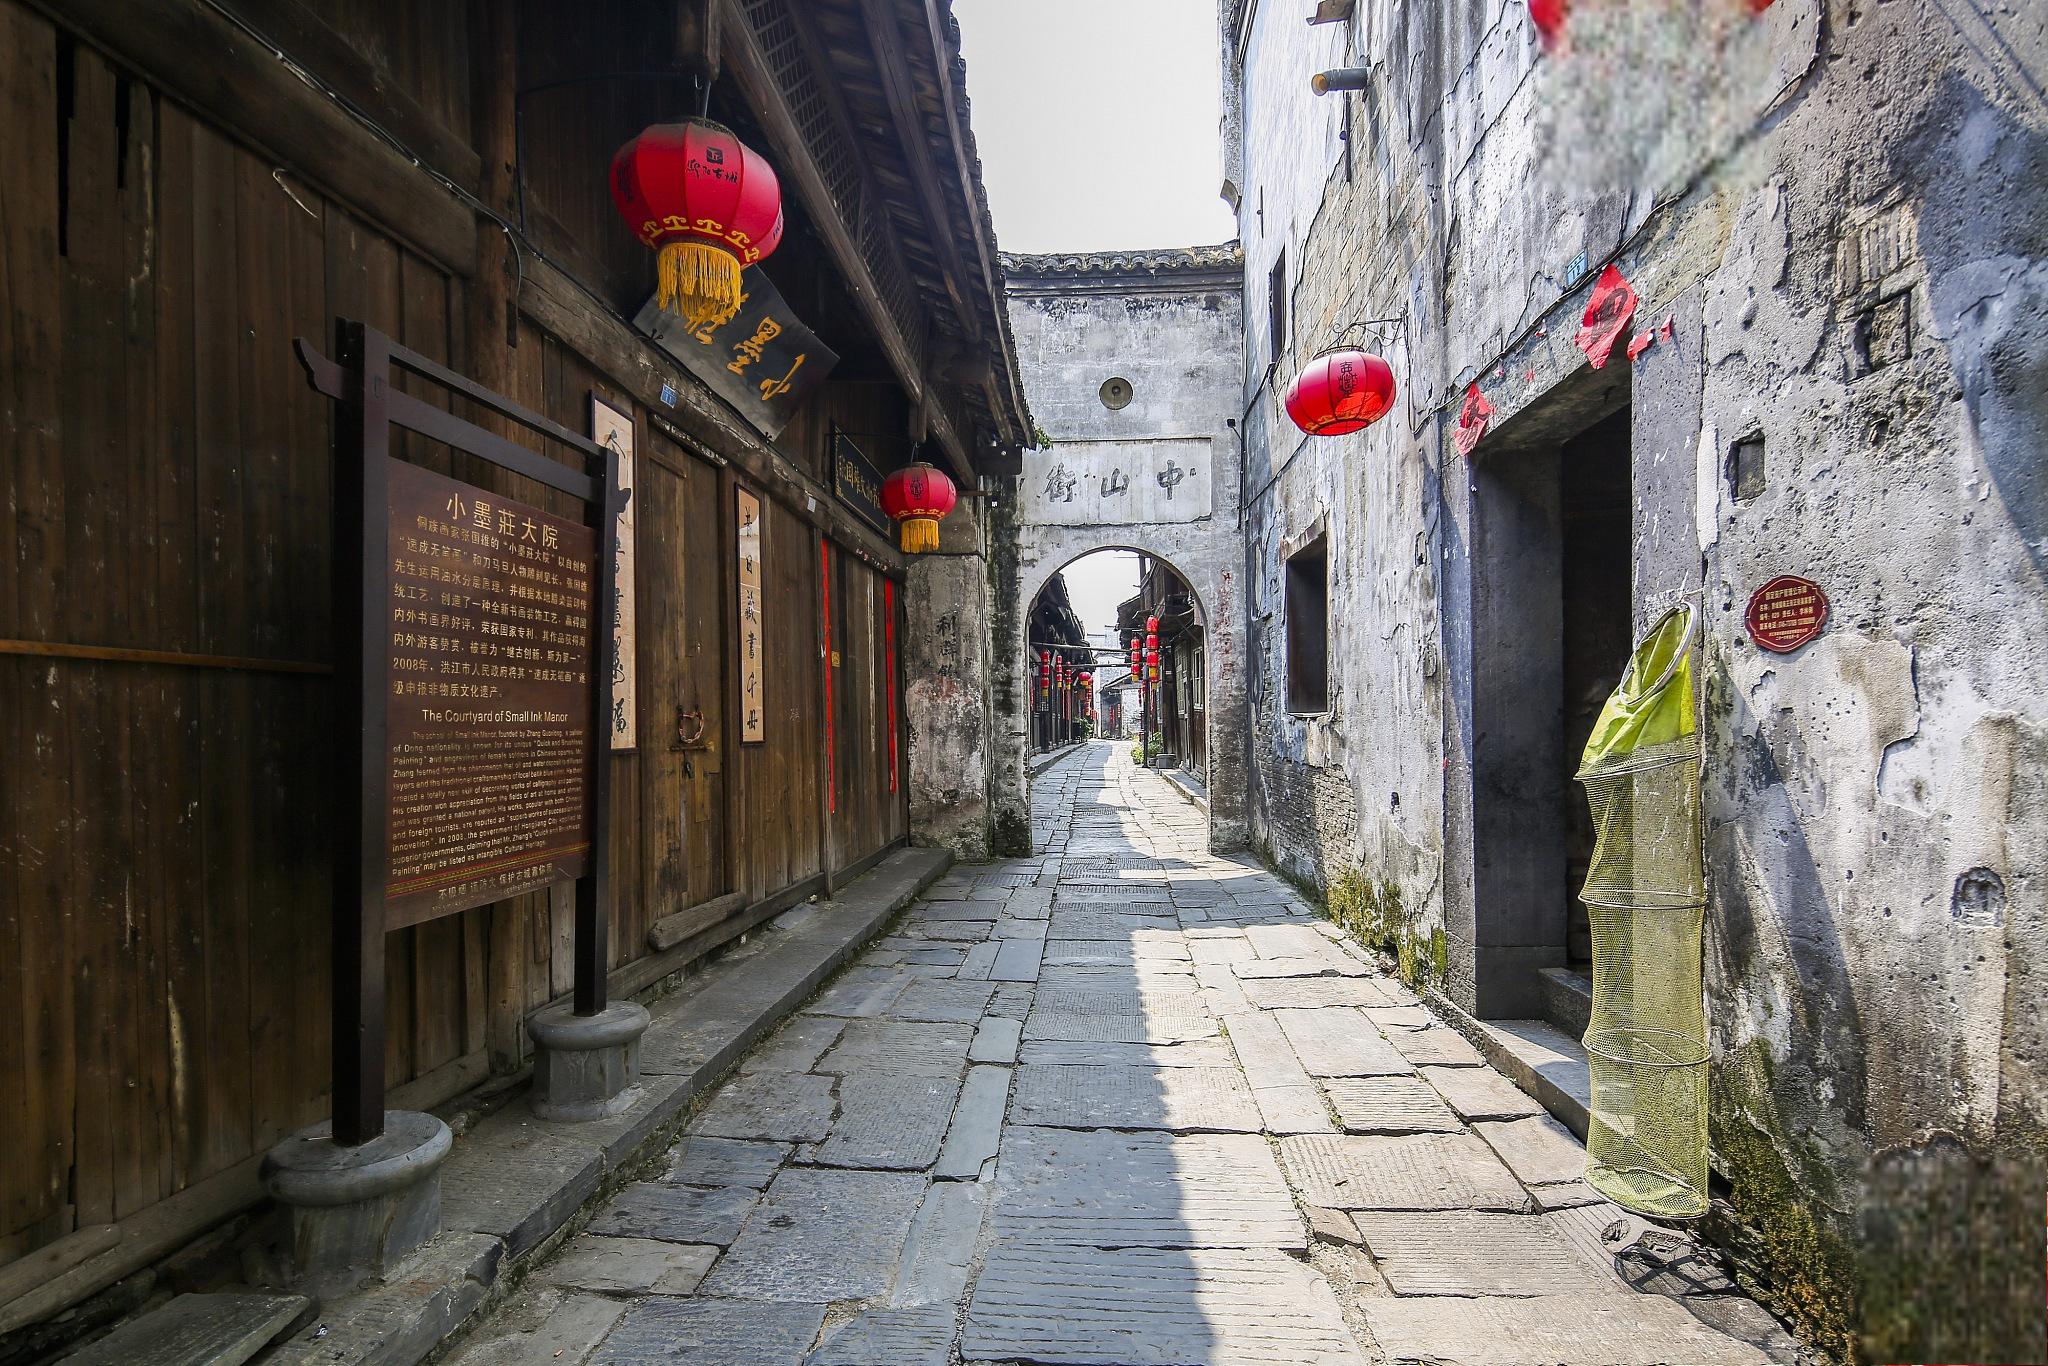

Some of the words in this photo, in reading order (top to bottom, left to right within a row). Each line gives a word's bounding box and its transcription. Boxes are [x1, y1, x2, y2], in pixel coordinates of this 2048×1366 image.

[445, 493, 558, 549] 小墨莊大院
[422, 708, 442, 721] The
[445, 709, 492, 724] Courtyard
[494, 709, 503, 721] of
[505, 709, 528, 721] Small
[530, 710, 542, 721] Ink
[544, 710, 568, 721] Manor
